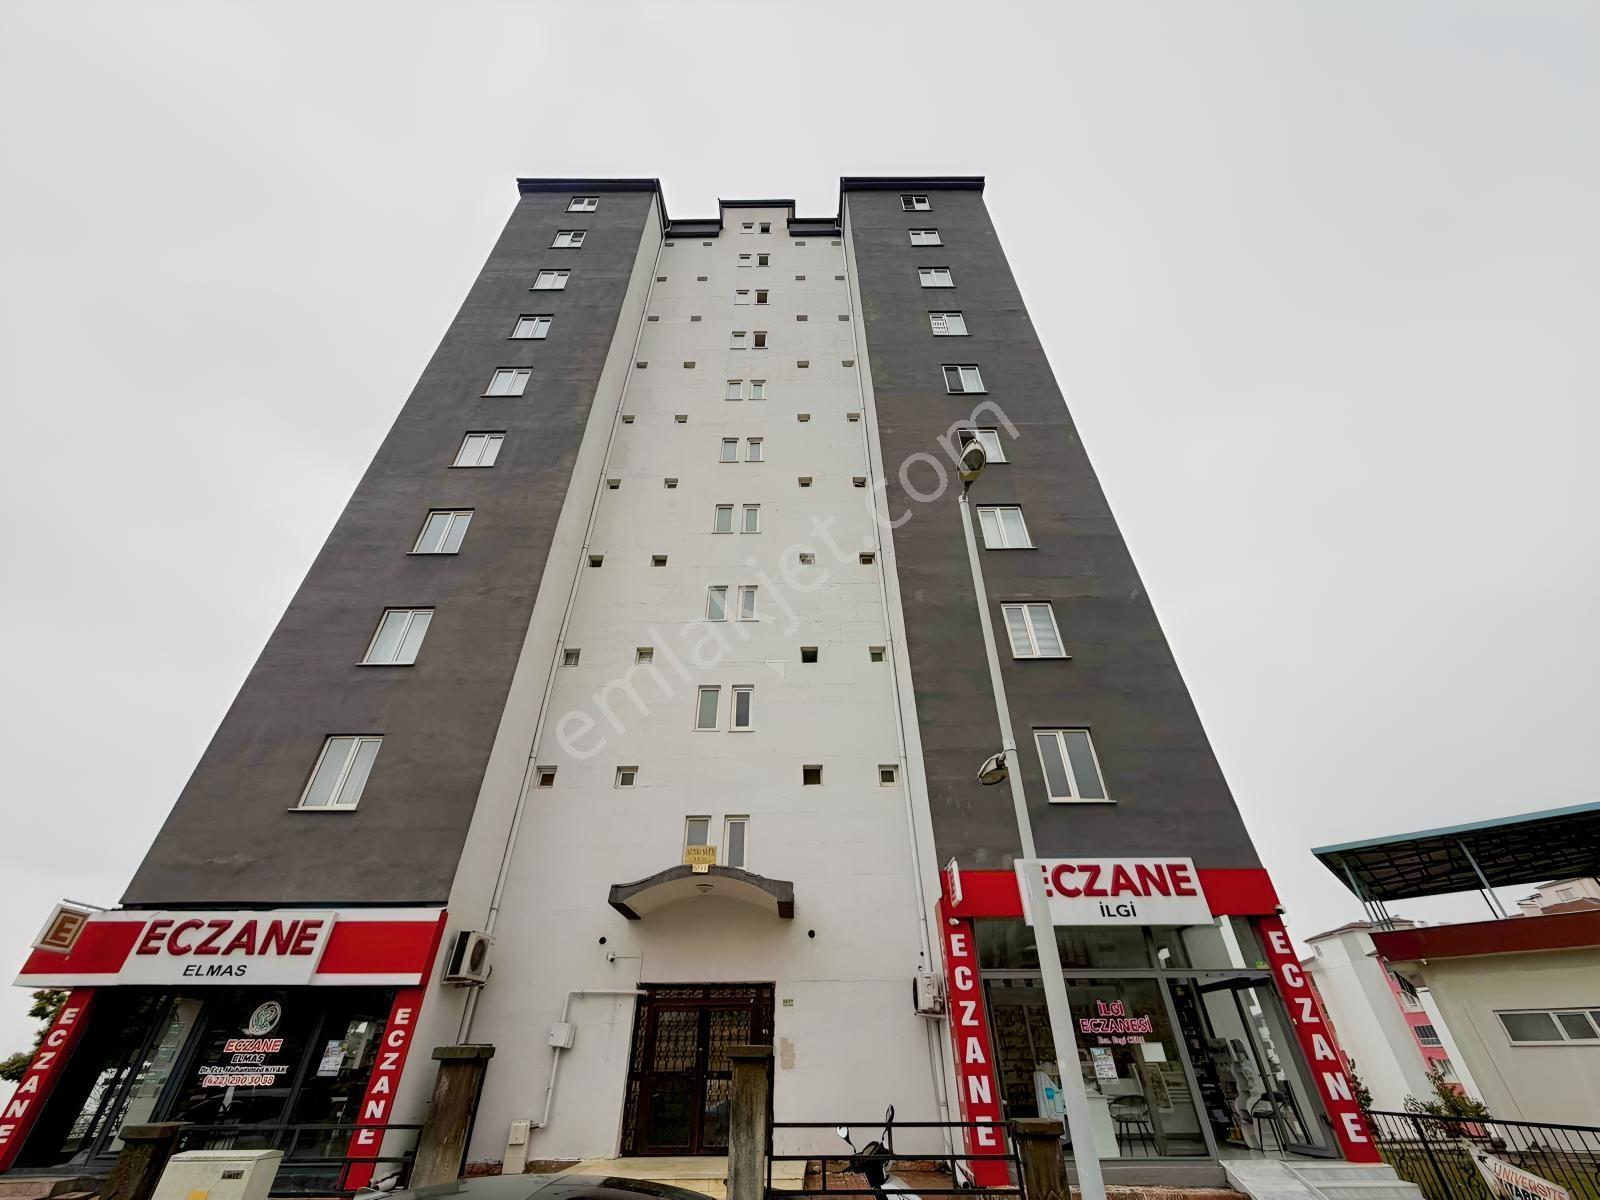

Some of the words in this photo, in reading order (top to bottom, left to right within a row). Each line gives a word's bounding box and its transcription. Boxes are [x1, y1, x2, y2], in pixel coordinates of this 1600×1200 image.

[1099, 901, 1137, 917] İLGİ
[49, 915, 80, 943] E
[136, 918, 324, 956] ECZANE
[182, 964, 248, 977] ELMAS
[1080, 1014, 1152, 1033] ECZANESİ
[223, 1038, 284, 1053] ECZANE
[950, 933, 996, 1146] ECZANE
[1268, 931, 1368, 1143] ECZANE
[231, 1053, 265, 1064] ELMAS
[357, 1008, 412, 1145] ECZANE
